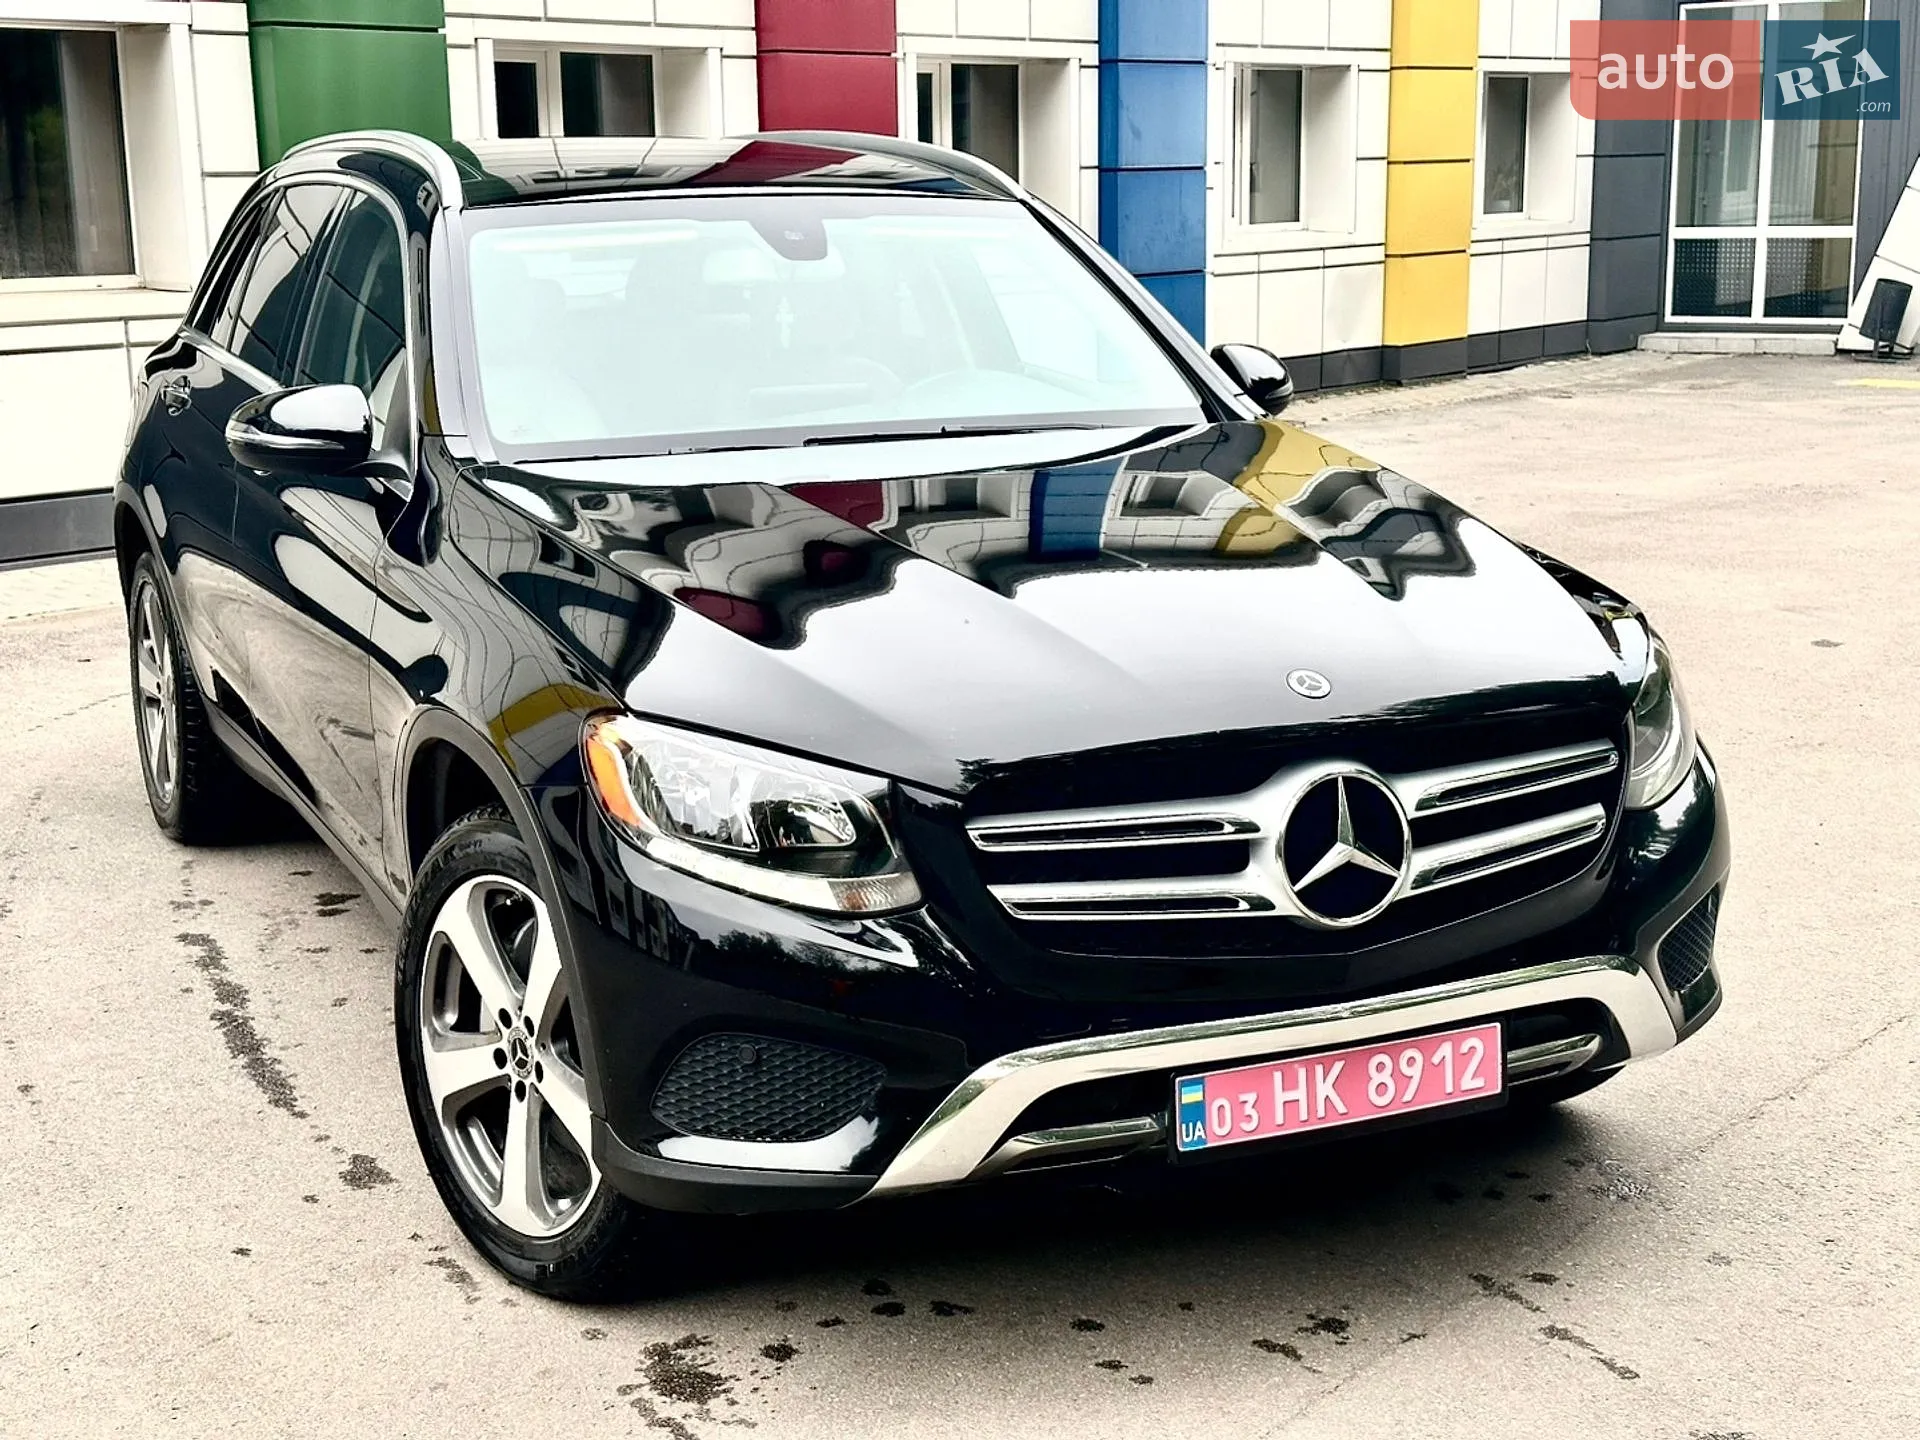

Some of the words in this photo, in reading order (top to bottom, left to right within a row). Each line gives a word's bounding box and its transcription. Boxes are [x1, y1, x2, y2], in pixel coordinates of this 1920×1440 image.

[1211, 1092, 1259, 1137] 03
[1272, 1060, 1348, 1126] HK
[1367, 1037, 1486, 1108] 8912
[1181, 1121, 1207, 1143] UA
